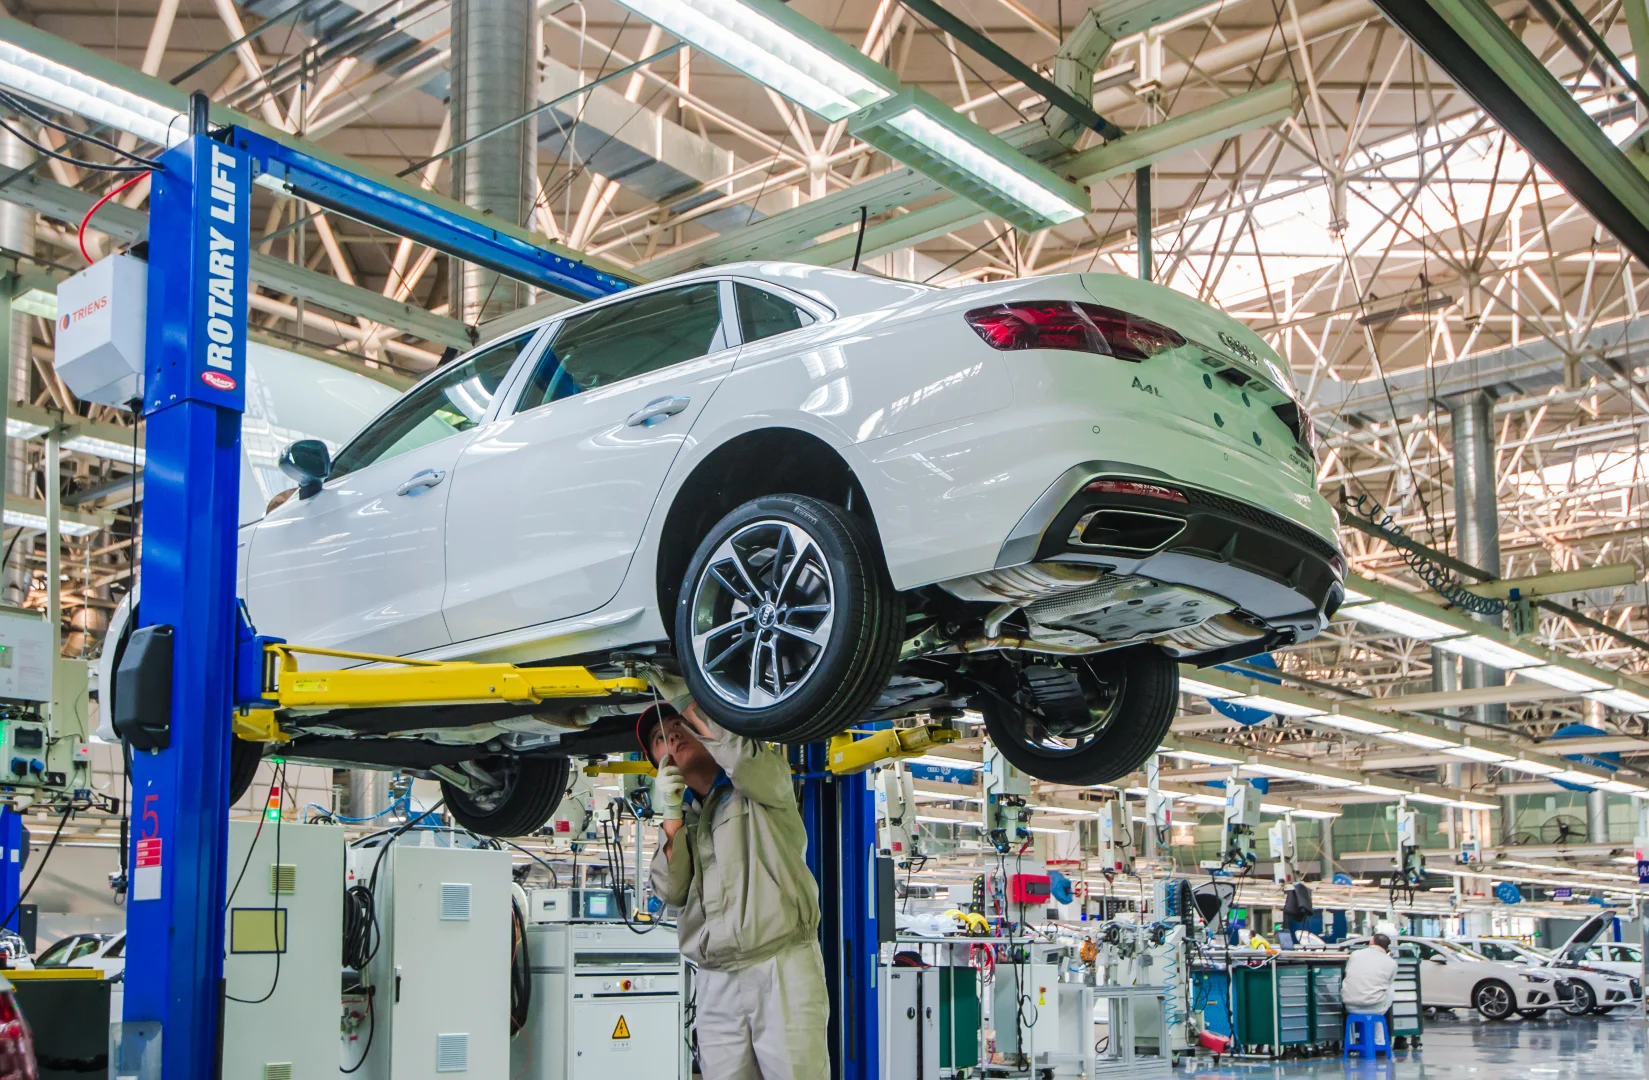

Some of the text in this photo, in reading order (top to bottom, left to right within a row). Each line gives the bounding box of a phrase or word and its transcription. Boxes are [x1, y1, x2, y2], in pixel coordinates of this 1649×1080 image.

[207, 144, 236, 371] ROTARY LIFT
[72, 295, 107, 323] TRIENS
[1131, 375, 1163, 398] A4L
[141, 794, 159, 840] 5
